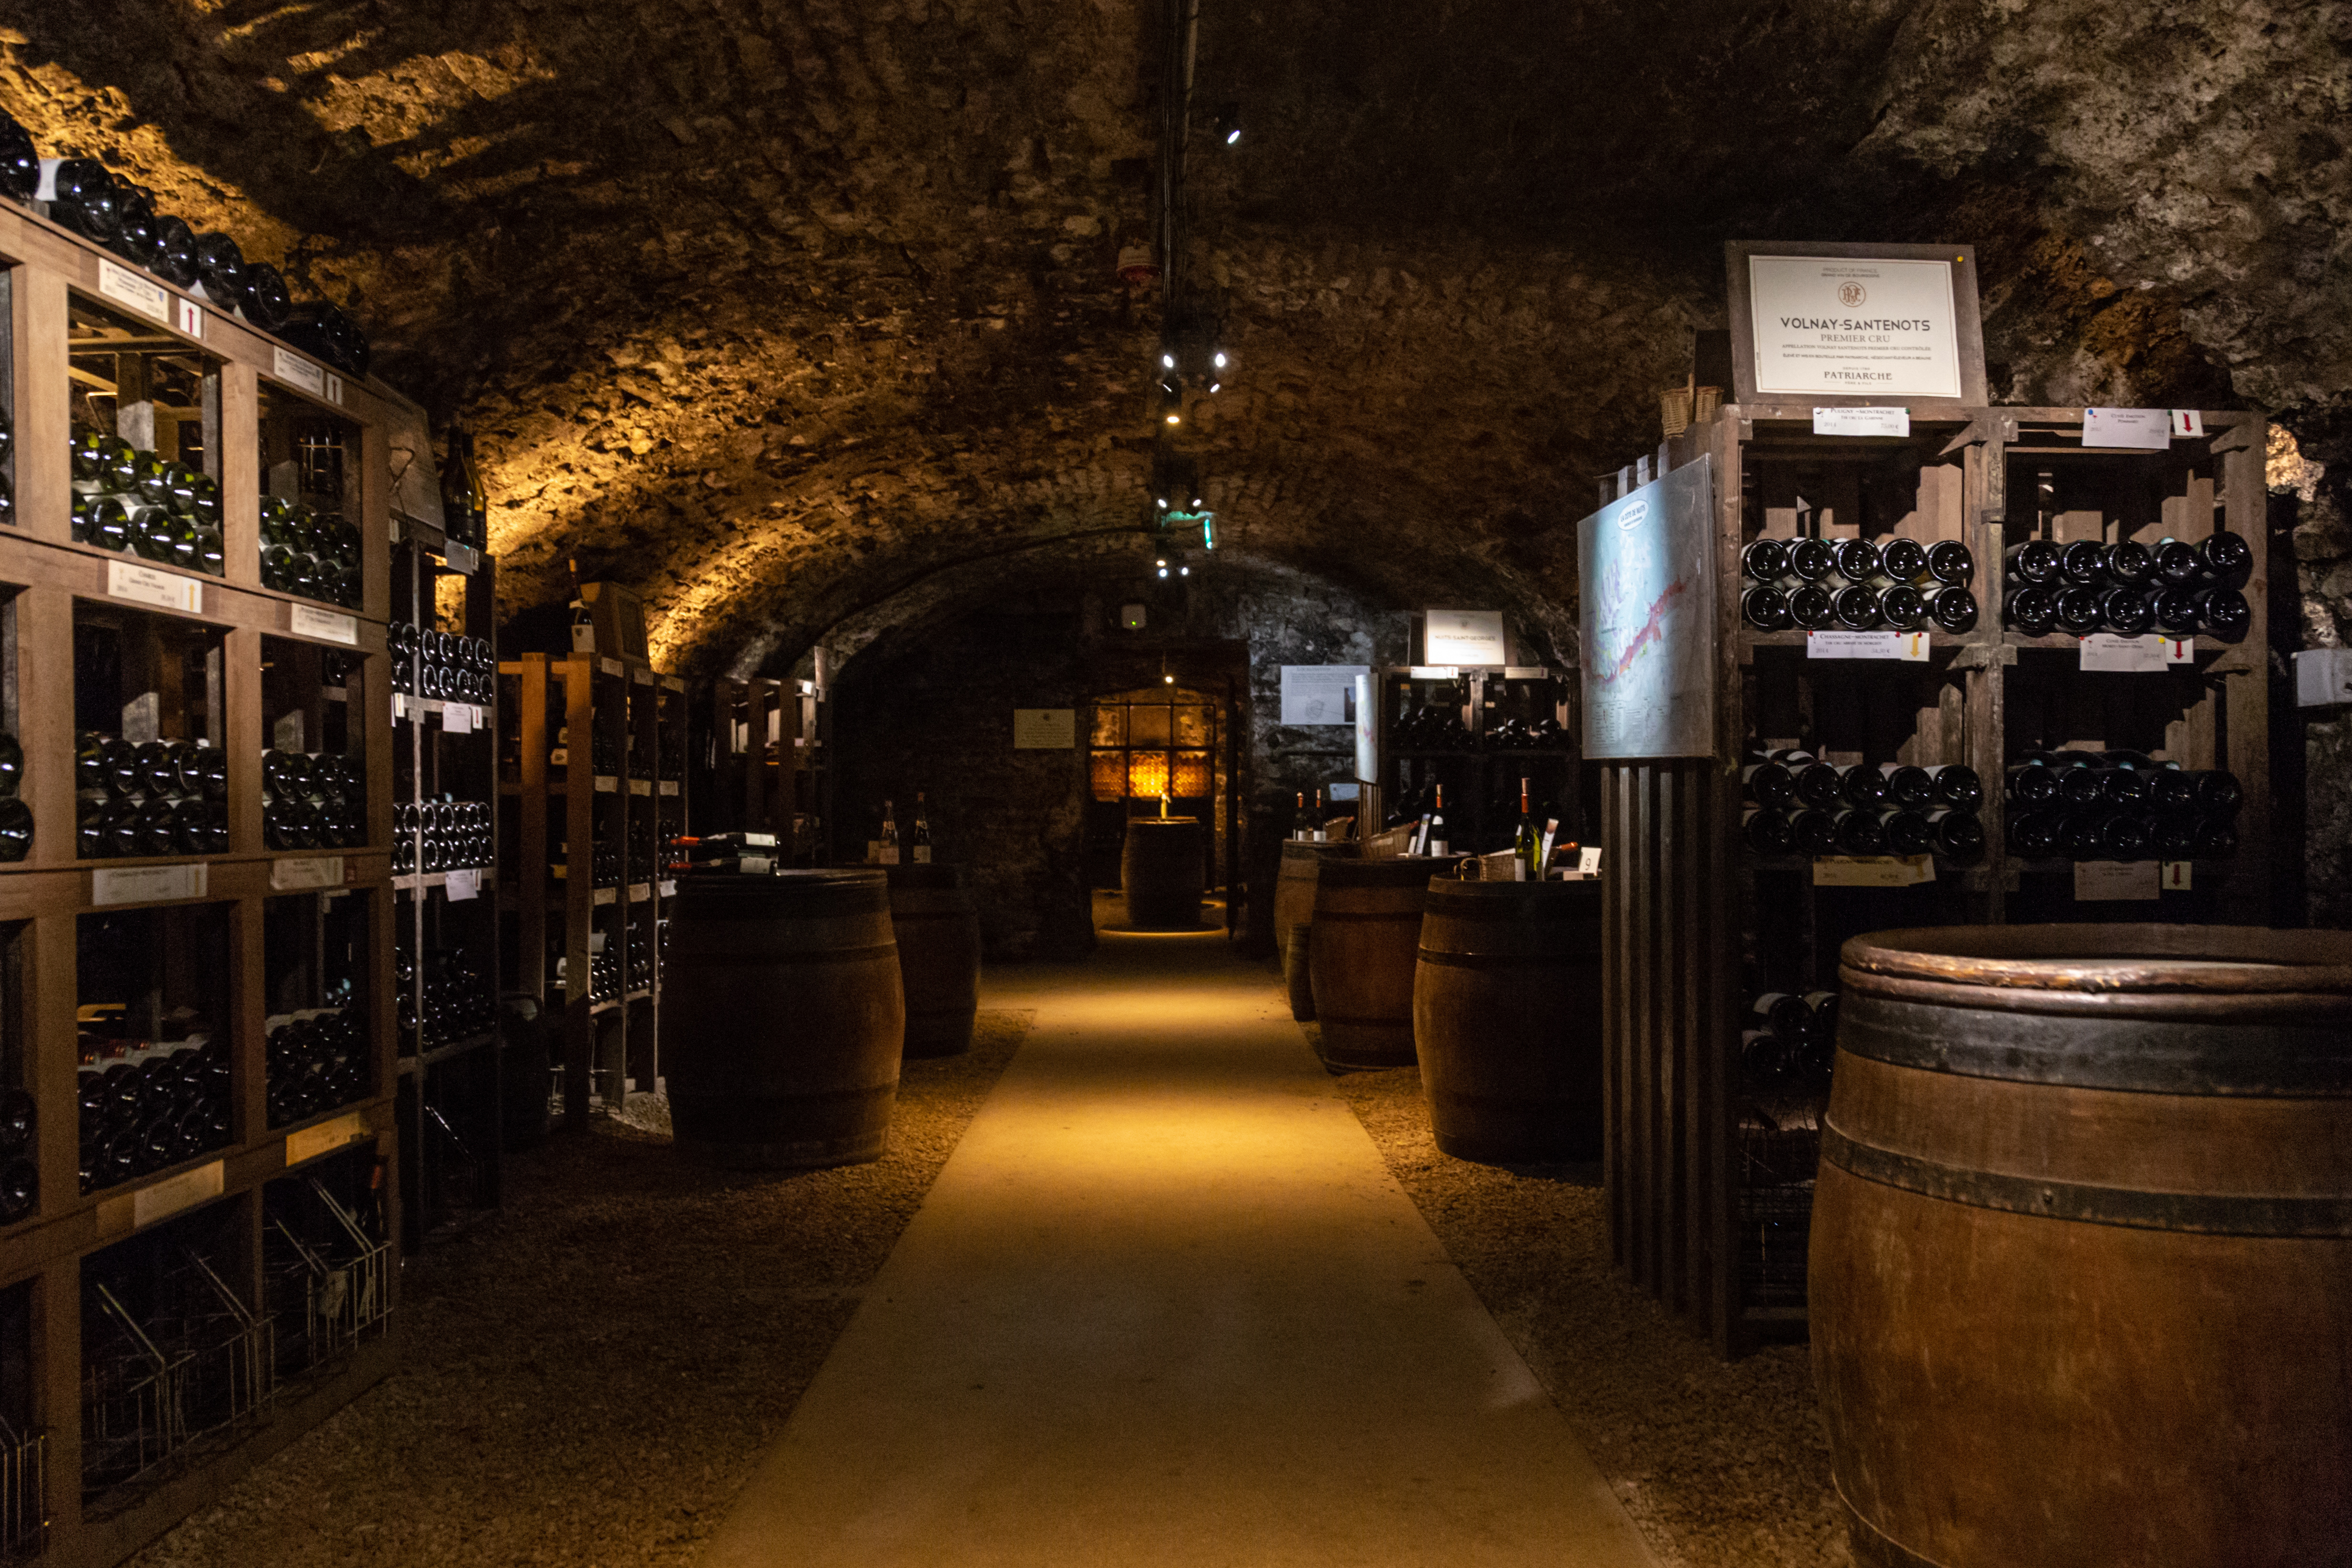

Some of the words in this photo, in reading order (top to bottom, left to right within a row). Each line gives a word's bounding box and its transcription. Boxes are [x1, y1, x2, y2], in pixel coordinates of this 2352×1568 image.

[1780, 317, 1931, 331] VOLNAY-SANTENOTS
[1821, 334, 1866, 342] PREMIER
[1868, 335, 1891, 343] CRU
[1824, 371, 1892, 380] PATRIARCHE
[1585, 858, 1592, 871] 9
